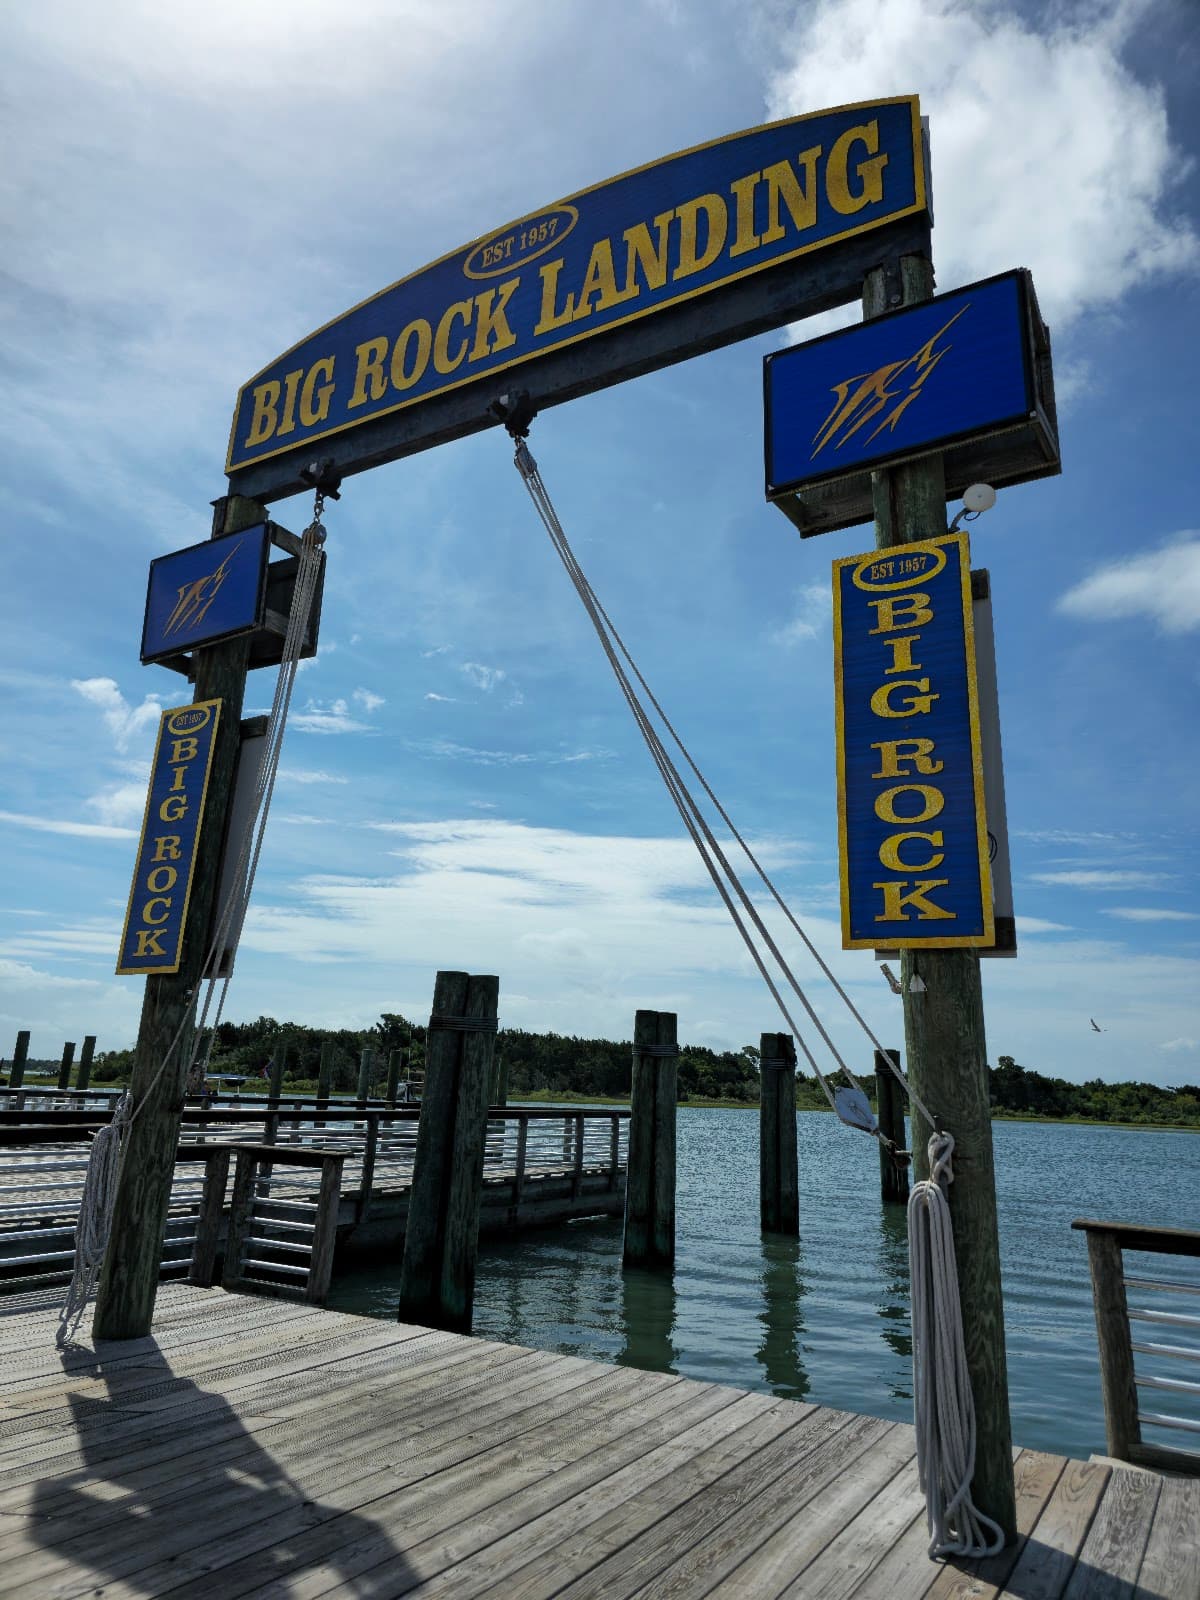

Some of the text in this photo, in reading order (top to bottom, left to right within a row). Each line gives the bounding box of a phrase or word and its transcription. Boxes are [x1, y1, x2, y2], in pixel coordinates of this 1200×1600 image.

[245, 120, 889, 448] BIG ROCK LANDING
[481, 217, 559, 268] EST 1957
[871, 556, 927, 581] EST 1957
[867, 592, 939, 718] BIG
[159, 737, 198, 822] BIG
[871, 738, 956, 921] ROCK
[133, 836, 181, 957] ROCK
